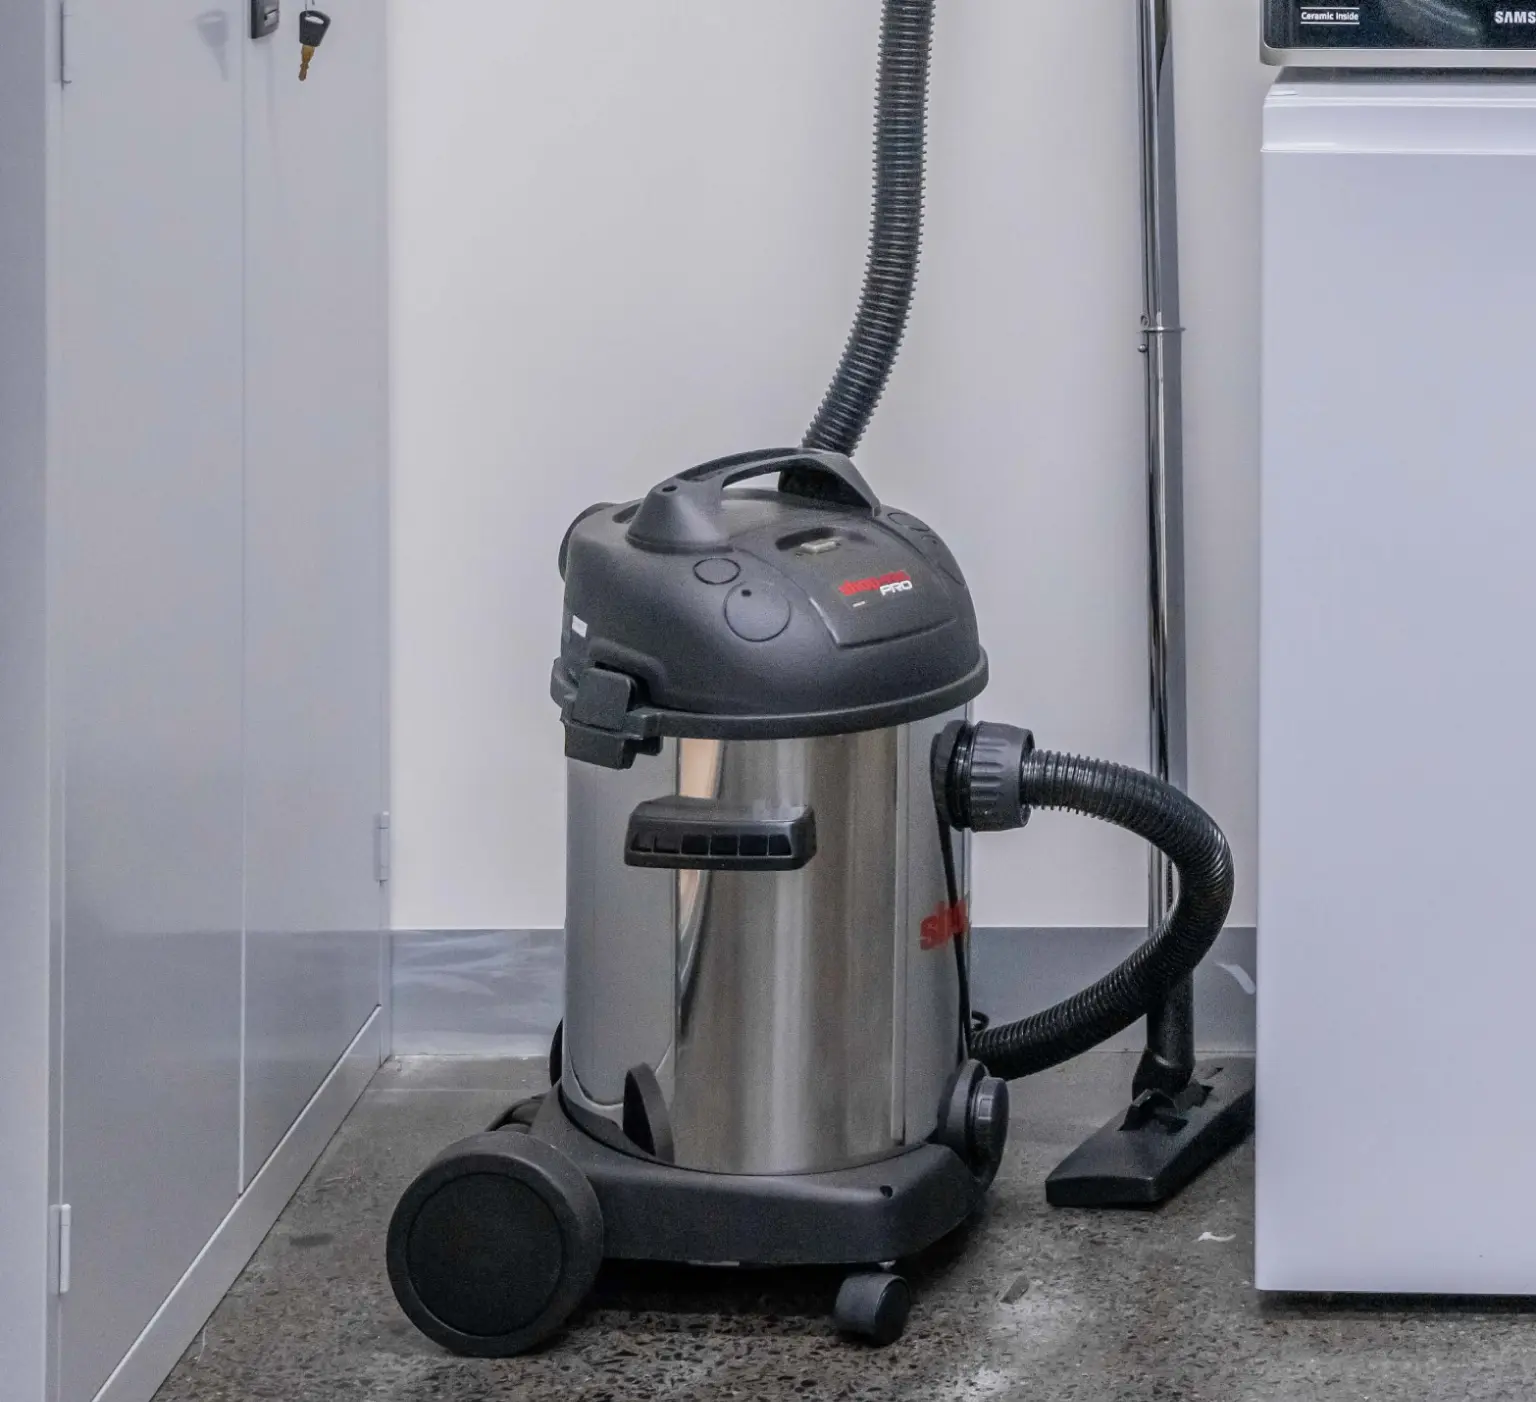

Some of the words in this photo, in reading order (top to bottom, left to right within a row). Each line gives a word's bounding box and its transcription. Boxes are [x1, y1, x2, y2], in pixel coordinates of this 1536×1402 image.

[1301, 11, 1334, 20] Ceramic
[1336, 12, 1359, 21] Inside
[879, 580, 913, 596] PRO
